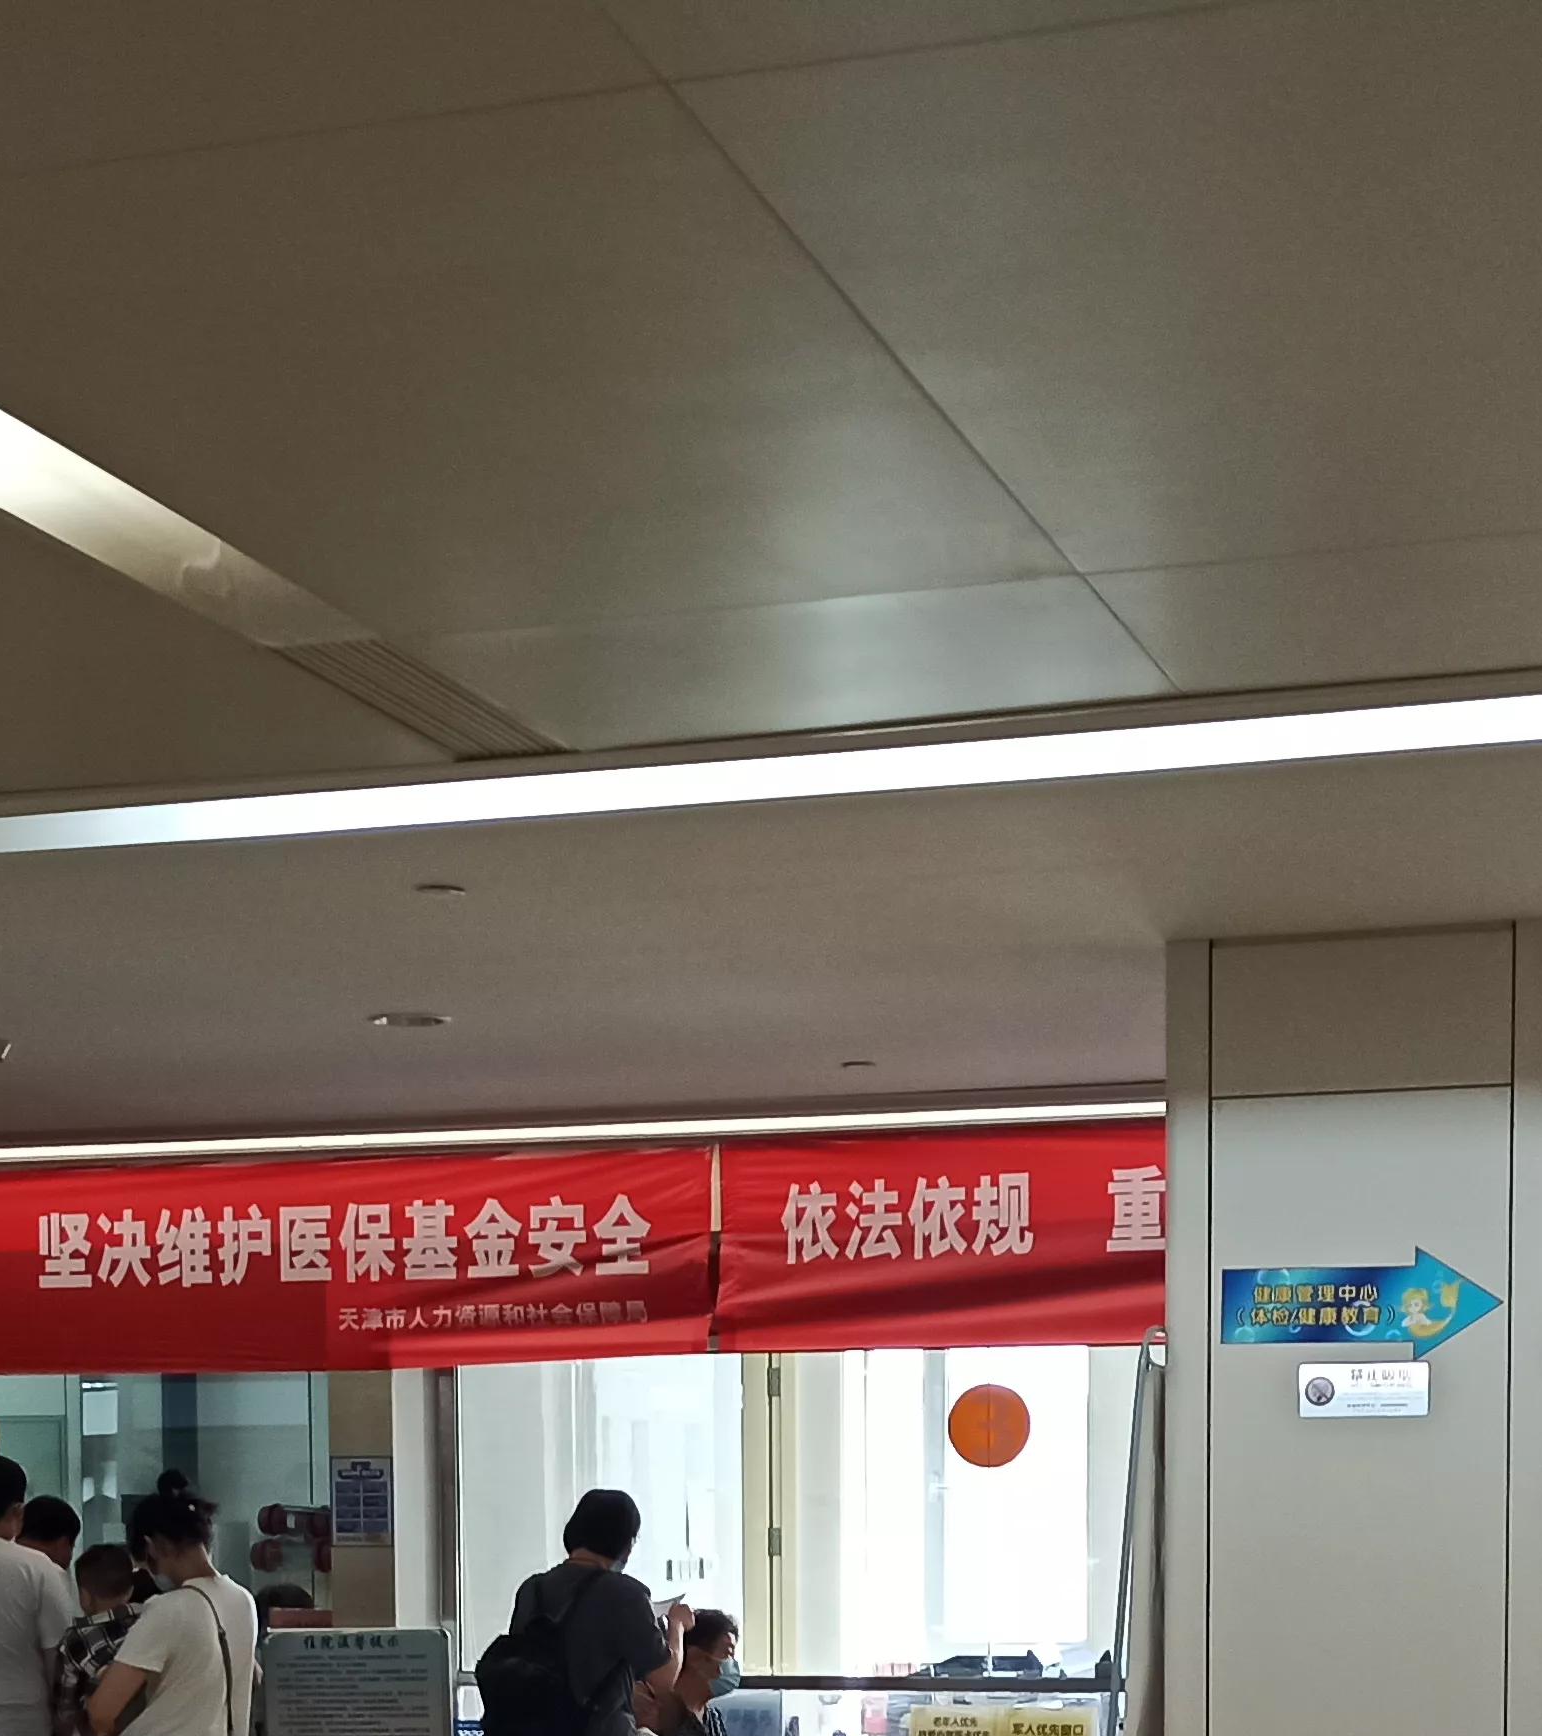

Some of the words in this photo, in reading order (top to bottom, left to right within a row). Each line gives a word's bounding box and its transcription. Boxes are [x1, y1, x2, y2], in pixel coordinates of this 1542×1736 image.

[39, 1194, 652, 1288] 坚决维护医保基金安全
[781, 1171, 1034, 1265] 依法依规
[1106, 1165, 1166, 1252] 重
[338, 1299, 648, 1331] 天津市人力资源和社会保障局
[1253, 1283, 1379, 1304] 健康管理中心
